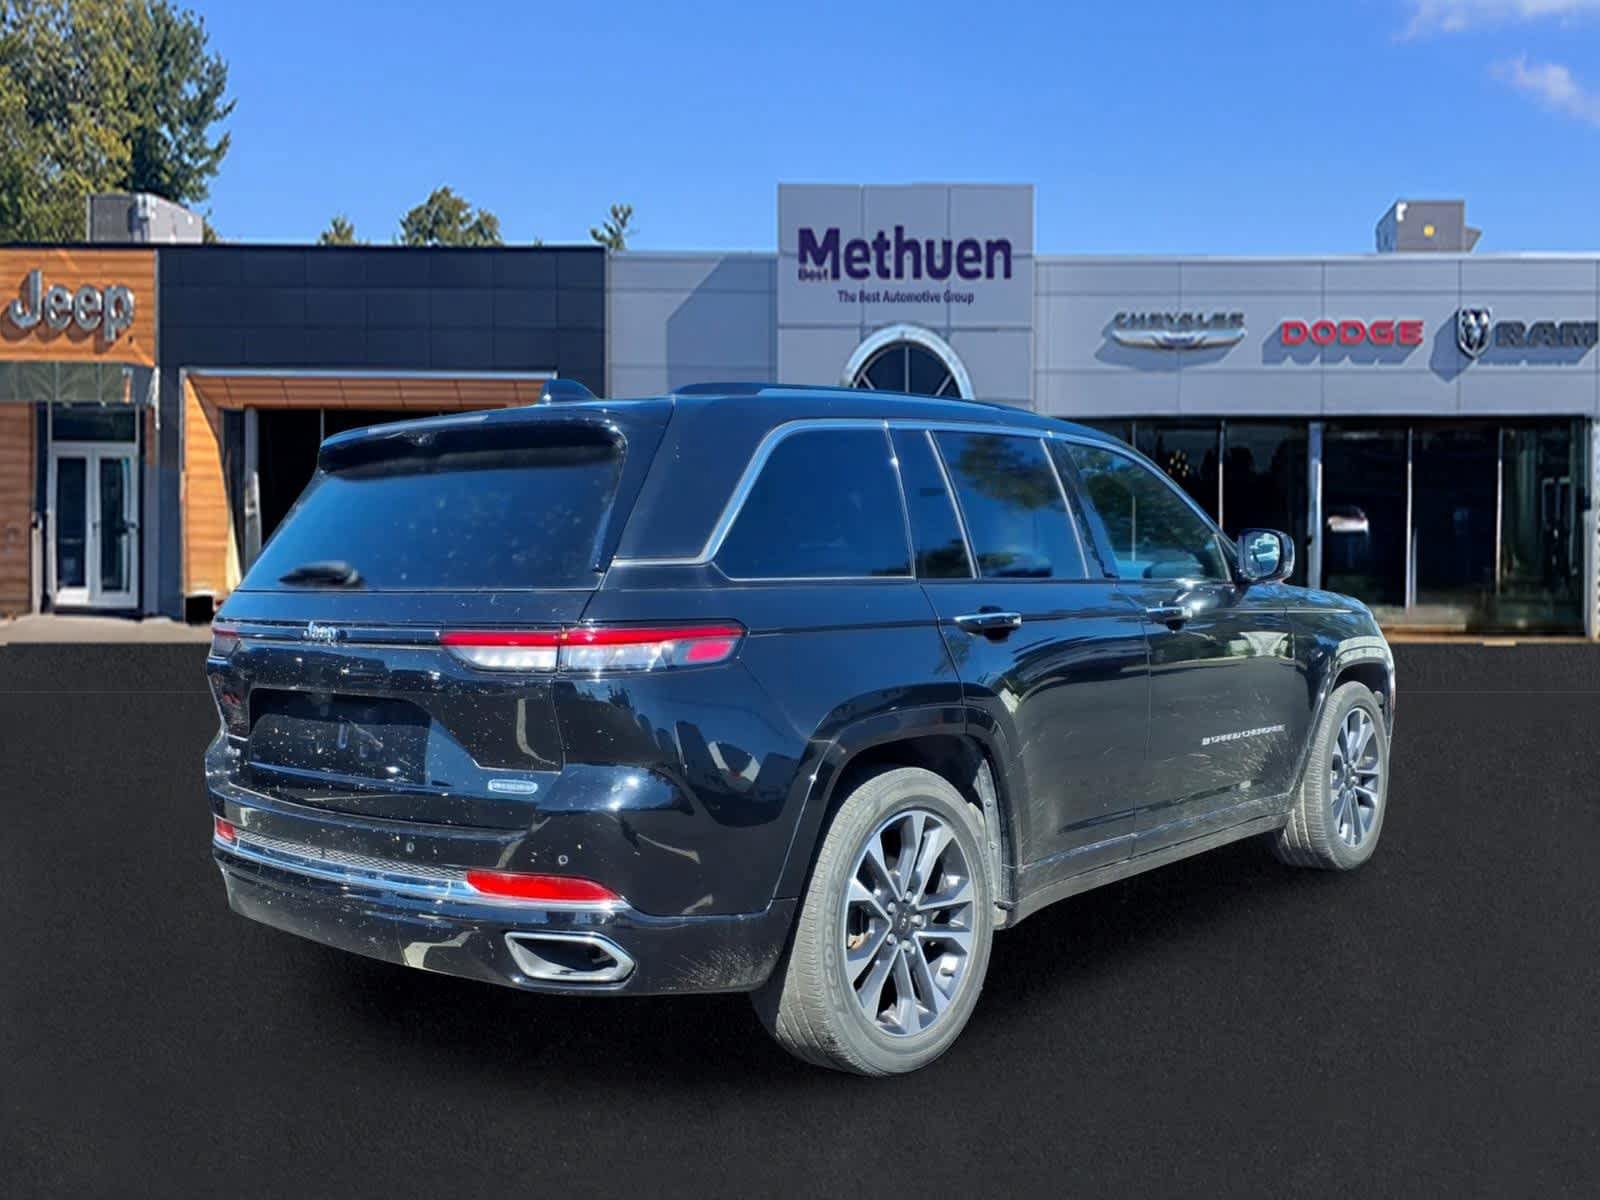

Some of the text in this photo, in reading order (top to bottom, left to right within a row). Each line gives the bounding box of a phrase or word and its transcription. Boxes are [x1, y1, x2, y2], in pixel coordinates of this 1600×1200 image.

[798, 225, 1012, 280] Methuen
[798, 268, 828, 282] Best
[9, 268, 134, 341] Jeep
[837, 290, 975, 306] The Best Automotive Group
[1114, 312, 1245, 328] CHRYSLER
[1281, 320, 1424, 345] DODGE
[1496, 321, 1599, 347] RAM
[302, 620, 337, 644] Jeep
